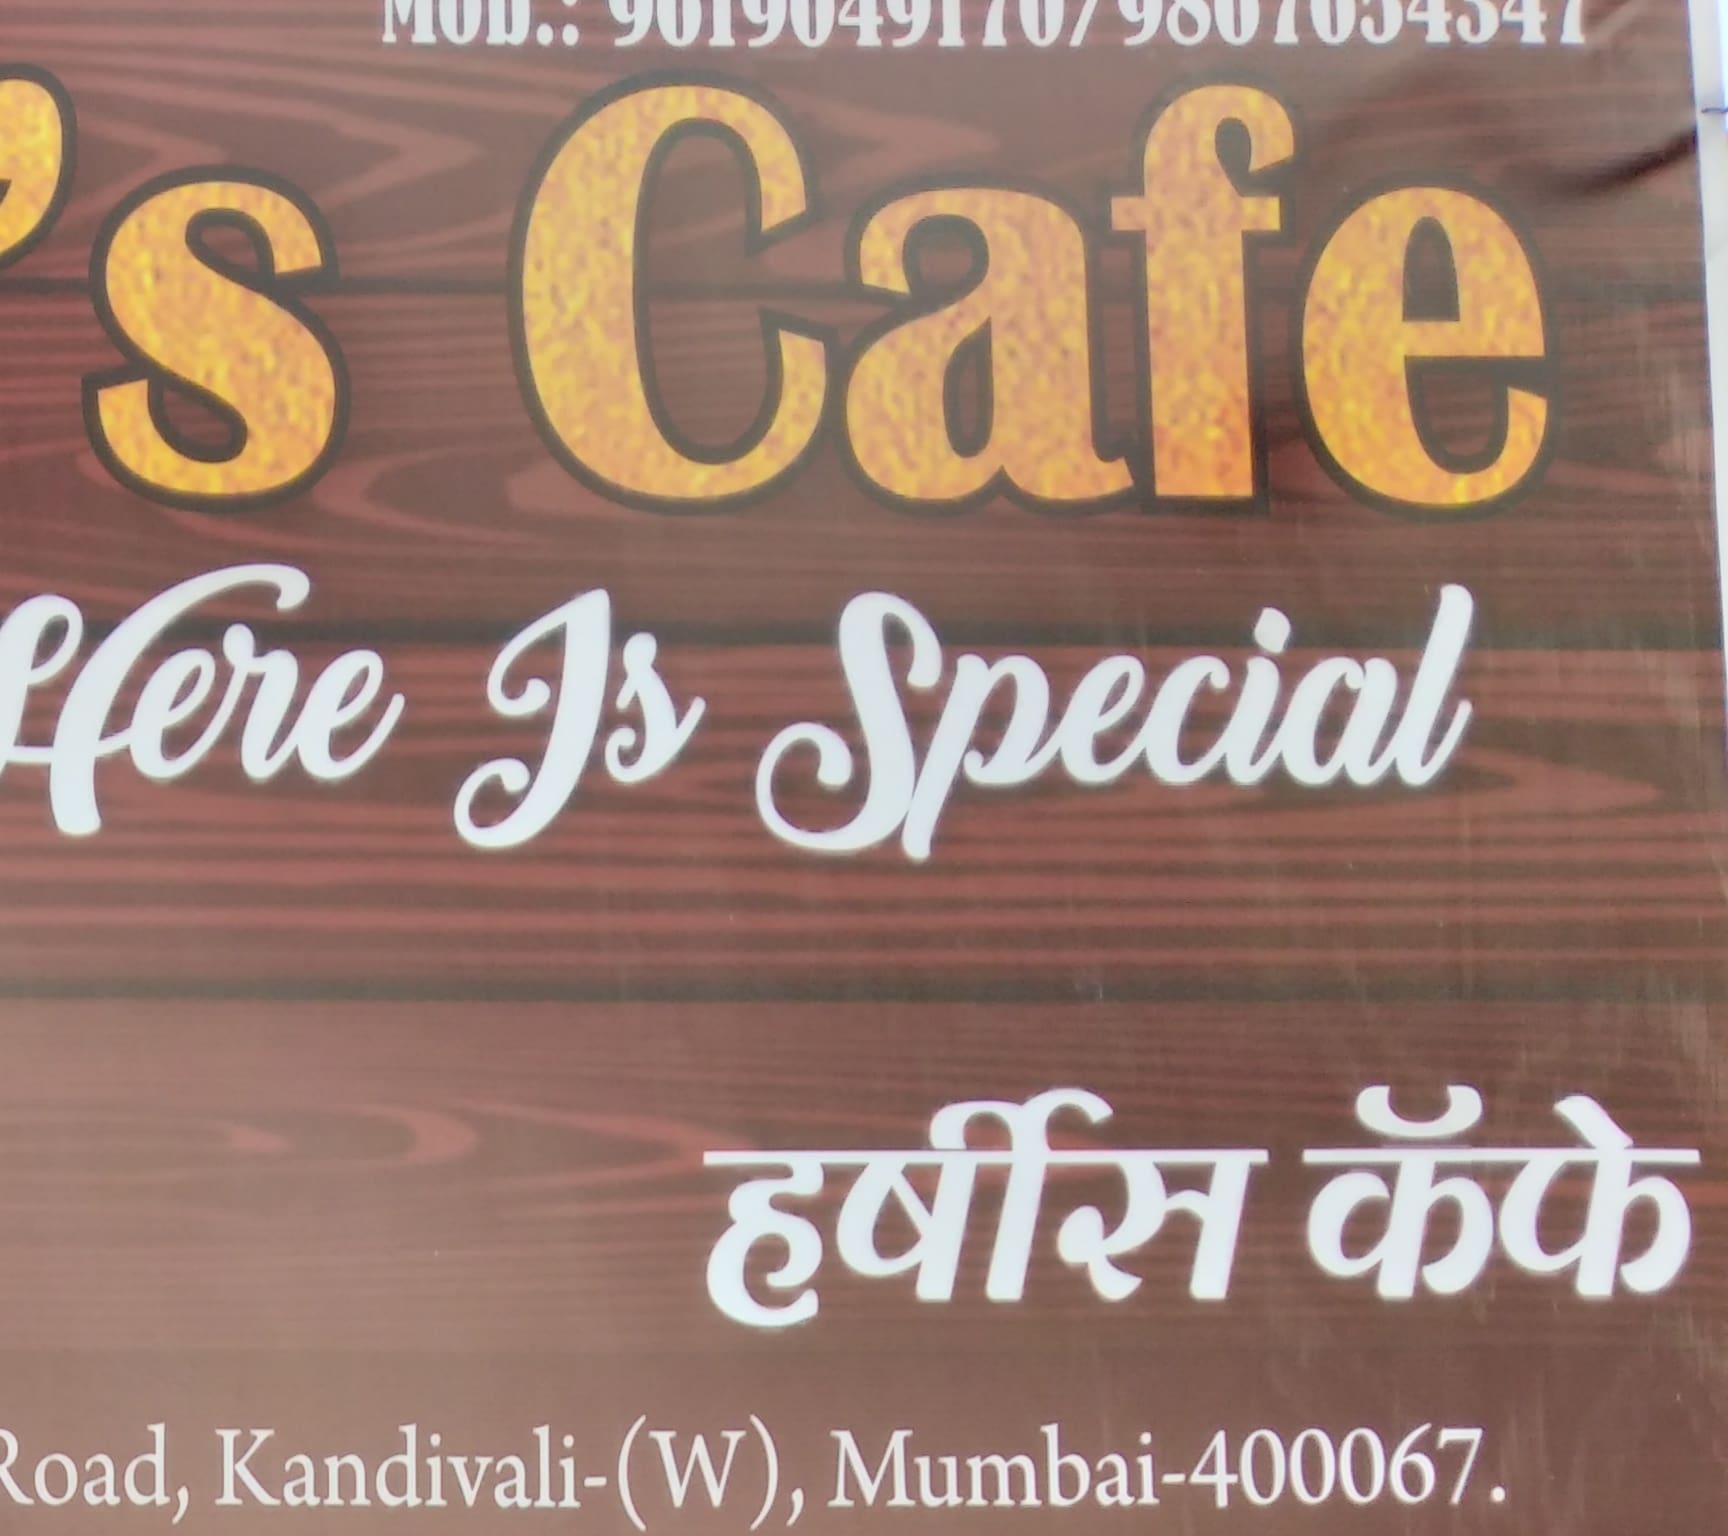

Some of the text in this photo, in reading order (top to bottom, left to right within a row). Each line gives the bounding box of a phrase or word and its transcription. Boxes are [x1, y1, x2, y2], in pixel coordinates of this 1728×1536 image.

[515, 76, 1552, 510] Cafe
[453, 588, 705, 849] Is
[755, 582, 1474, 861] Special
[702, 1085, 1702, 1328] हर्षीस कॅफे
[215, 1414, 804, 1531] Kandivali-(W),
[828, 1422, 1506, 1508] Mumbai-400067.
